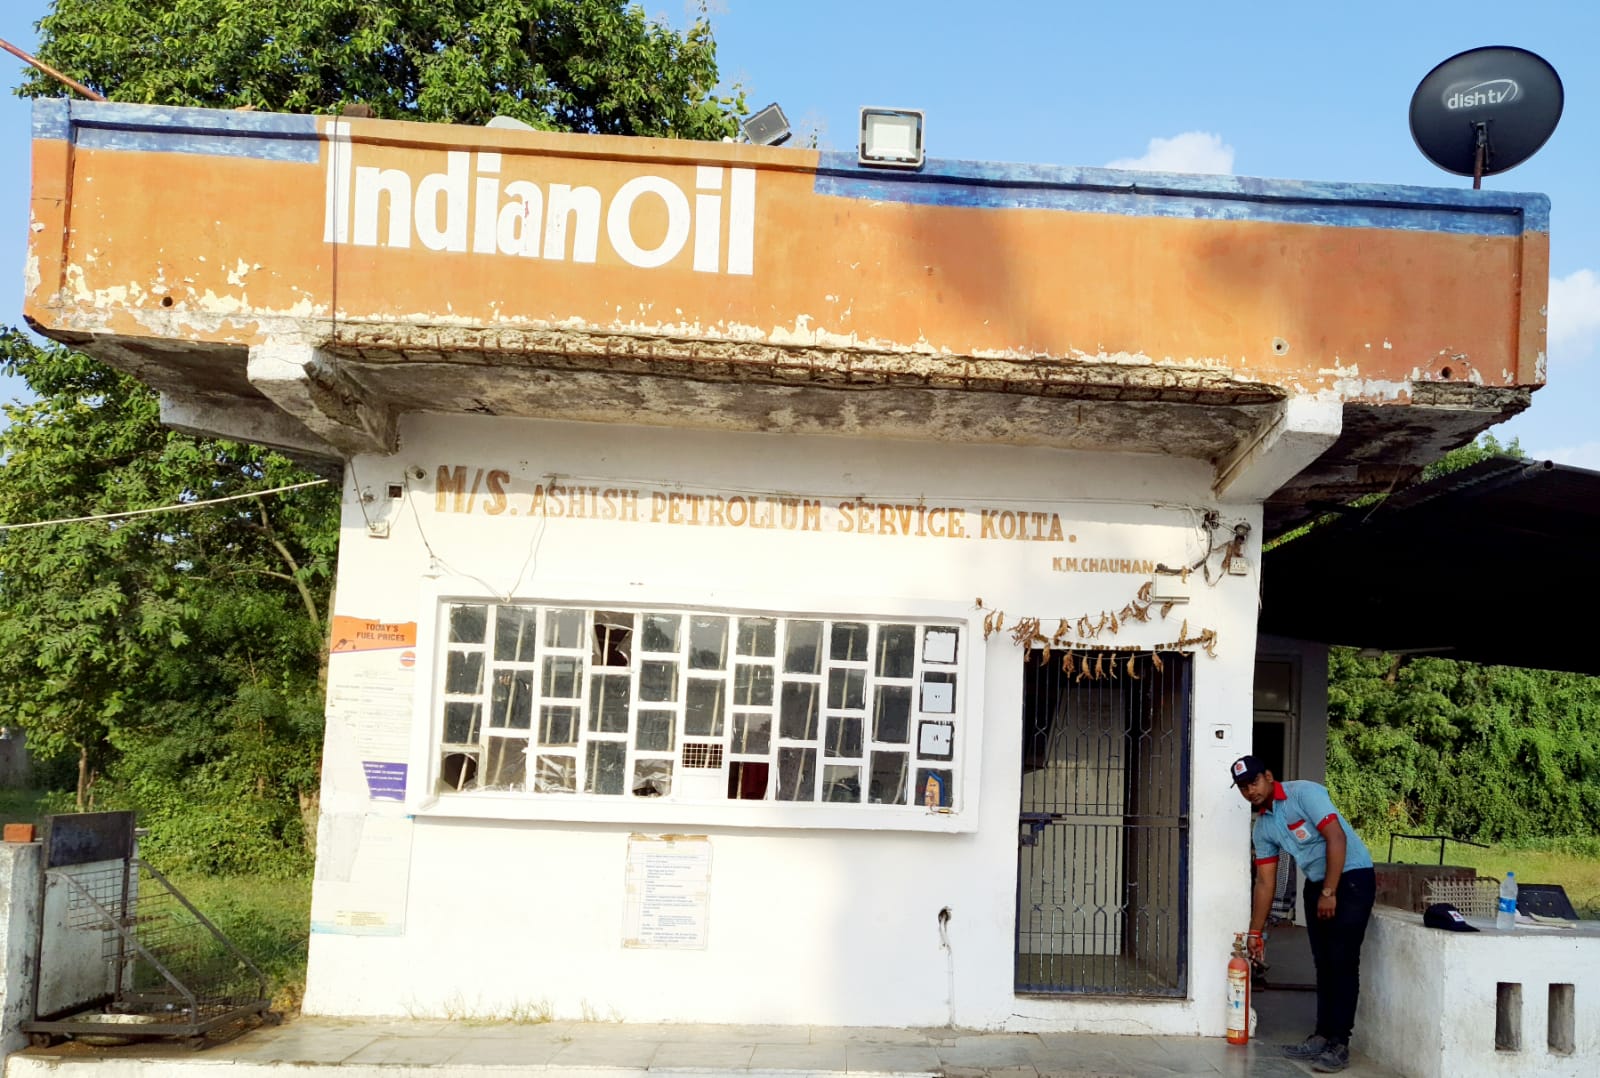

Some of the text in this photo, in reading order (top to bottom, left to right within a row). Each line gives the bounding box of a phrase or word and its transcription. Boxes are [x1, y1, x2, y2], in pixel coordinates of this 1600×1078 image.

[434, 464, 518, 516] M/S.
[356, 631, 405, 642] FUEL PRICES
